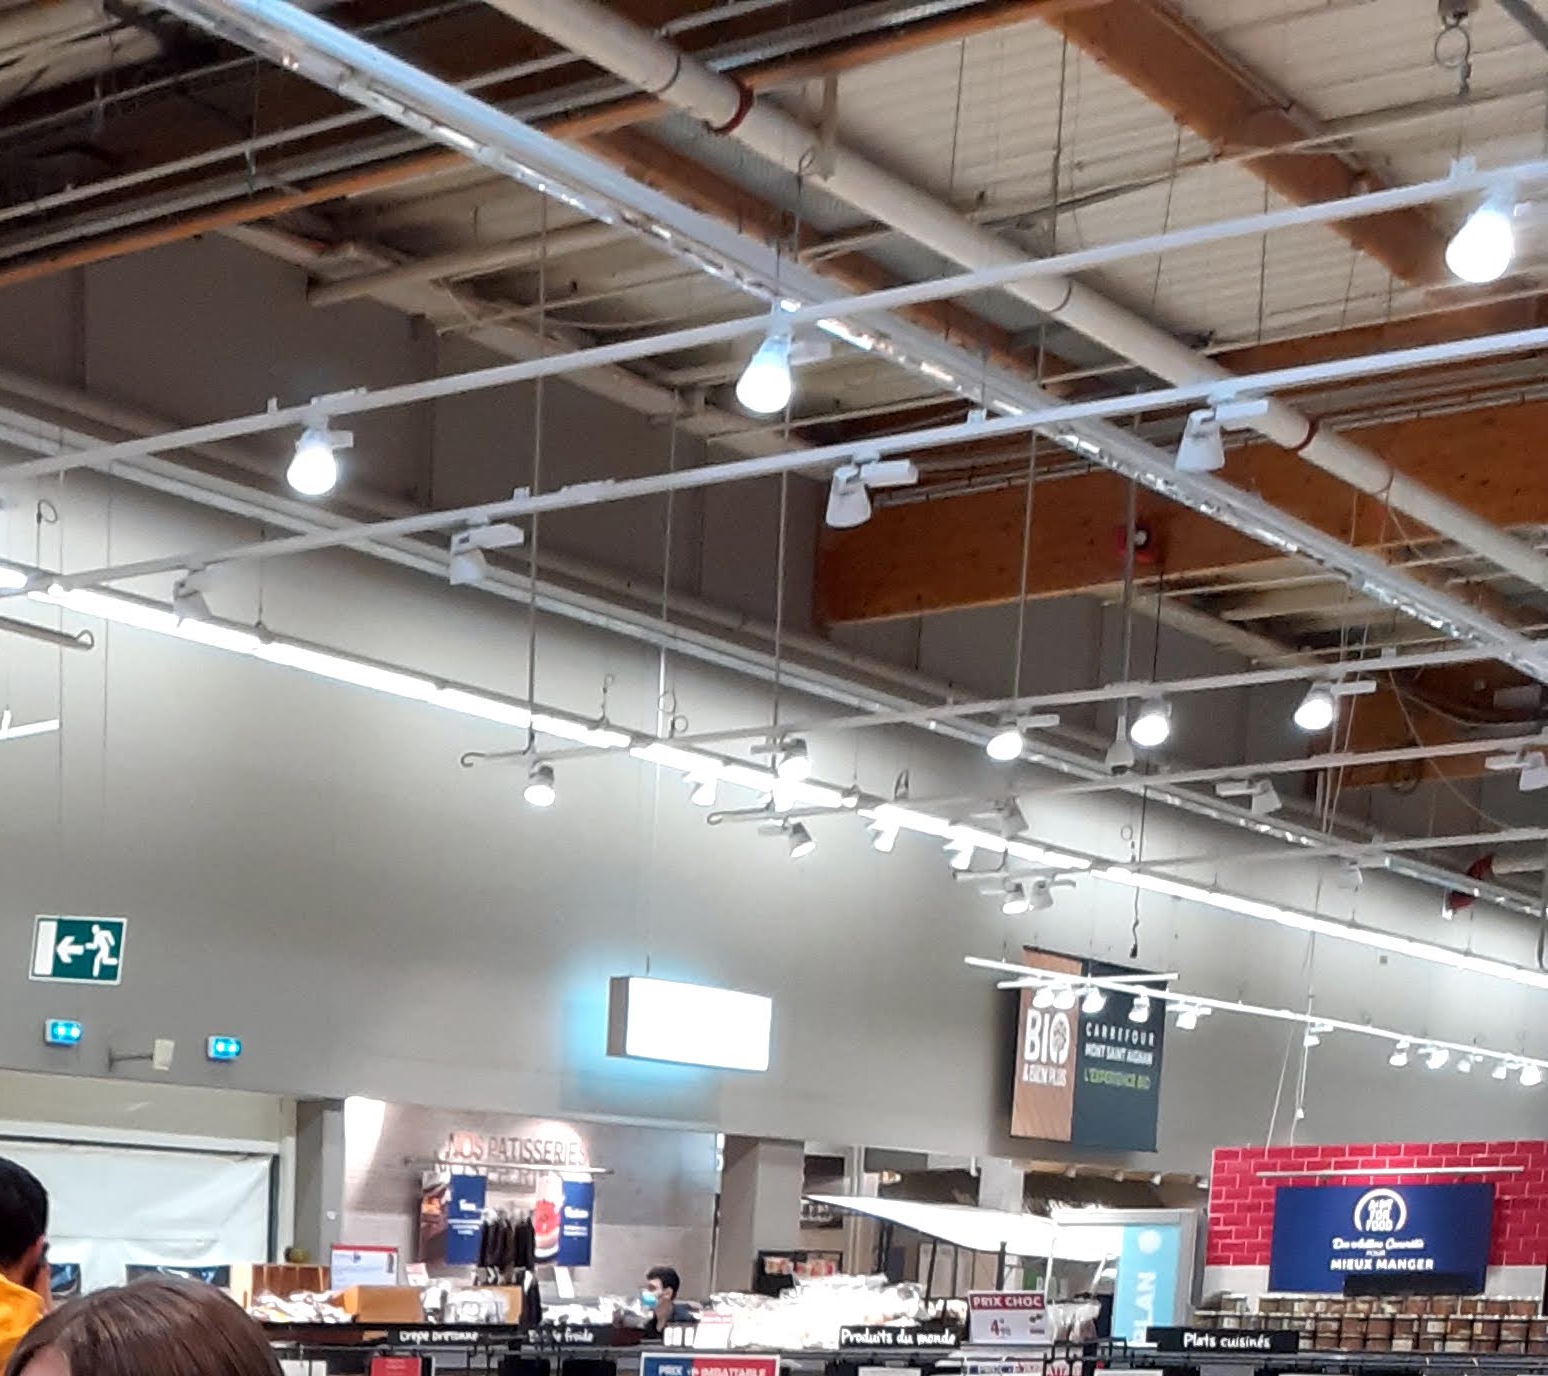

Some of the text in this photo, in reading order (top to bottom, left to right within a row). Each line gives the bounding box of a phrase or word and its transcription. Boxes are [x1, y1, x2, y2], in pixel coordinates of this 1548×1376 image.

[1024, 1008, 1071, 1065] BIO
[1085, 1021, 1155, 1047] CARREFOUR
[1330, 1258, 1434, 1271] MIEUX MANGER
[973, 1294, 1043, 1308] PRIX CHOC
[564, 1326, 595, 1343] froide
[841, 1329, 956, 1346] Produits du monde
[1183, 1331, 1271, 1350] Plats cuisinés
